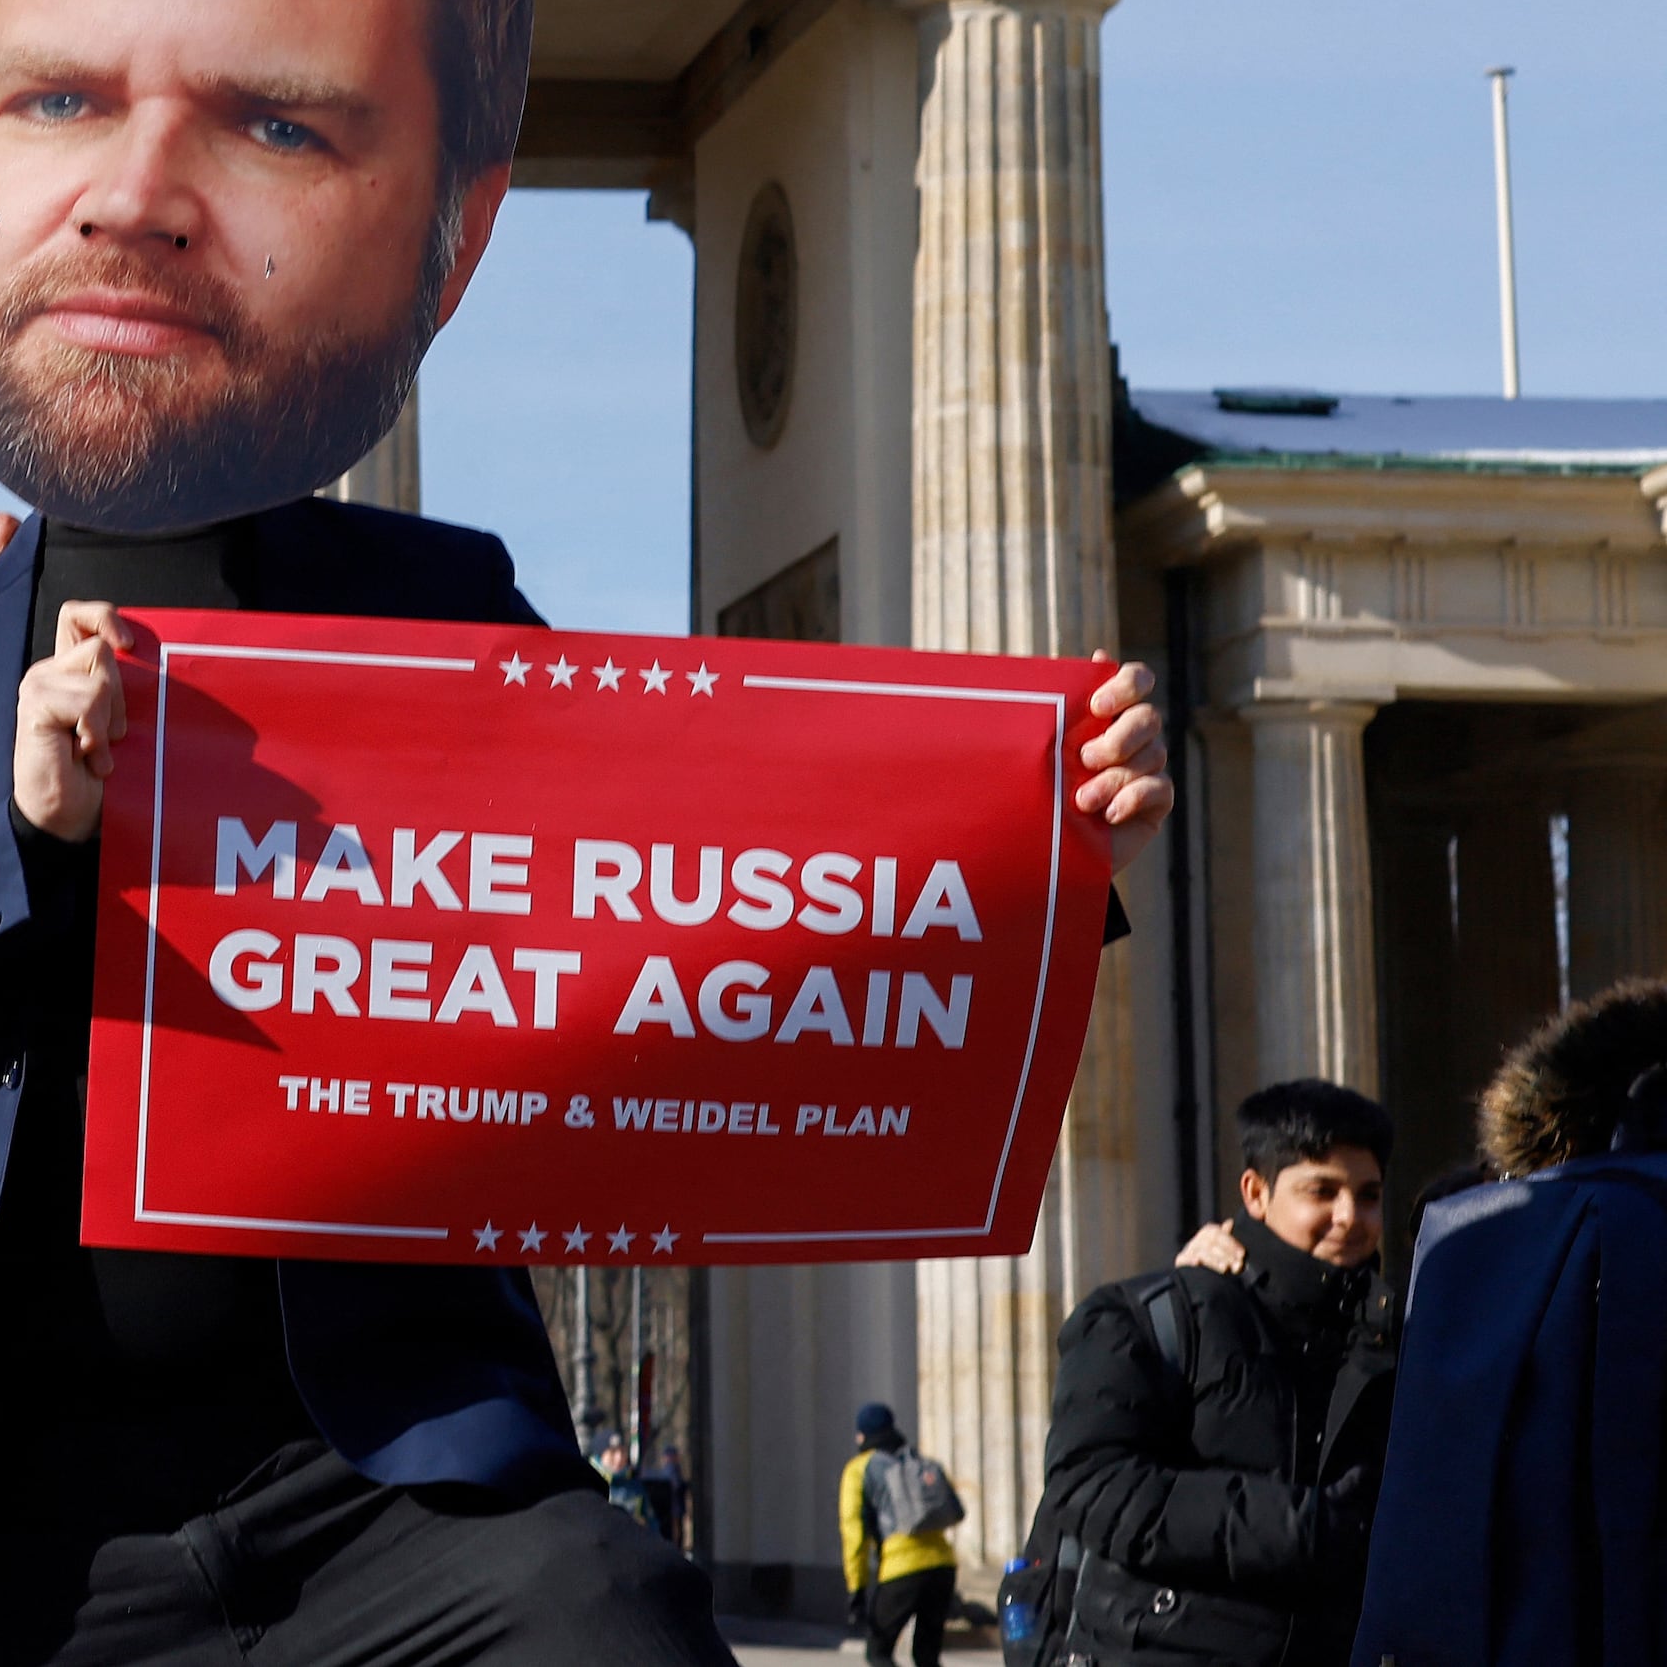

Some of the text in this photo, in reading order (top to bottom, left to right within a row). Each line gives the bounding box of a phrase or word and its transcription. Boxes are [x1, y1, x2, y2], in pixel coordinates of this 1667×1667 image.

[215, 817, 982, 941] MAKE RUSSIA
[209, 930, 972, 1047] GREAT AGAIN
[279, 1077, 910, 1134] THE TRUMP & WEIDEL PLAN
